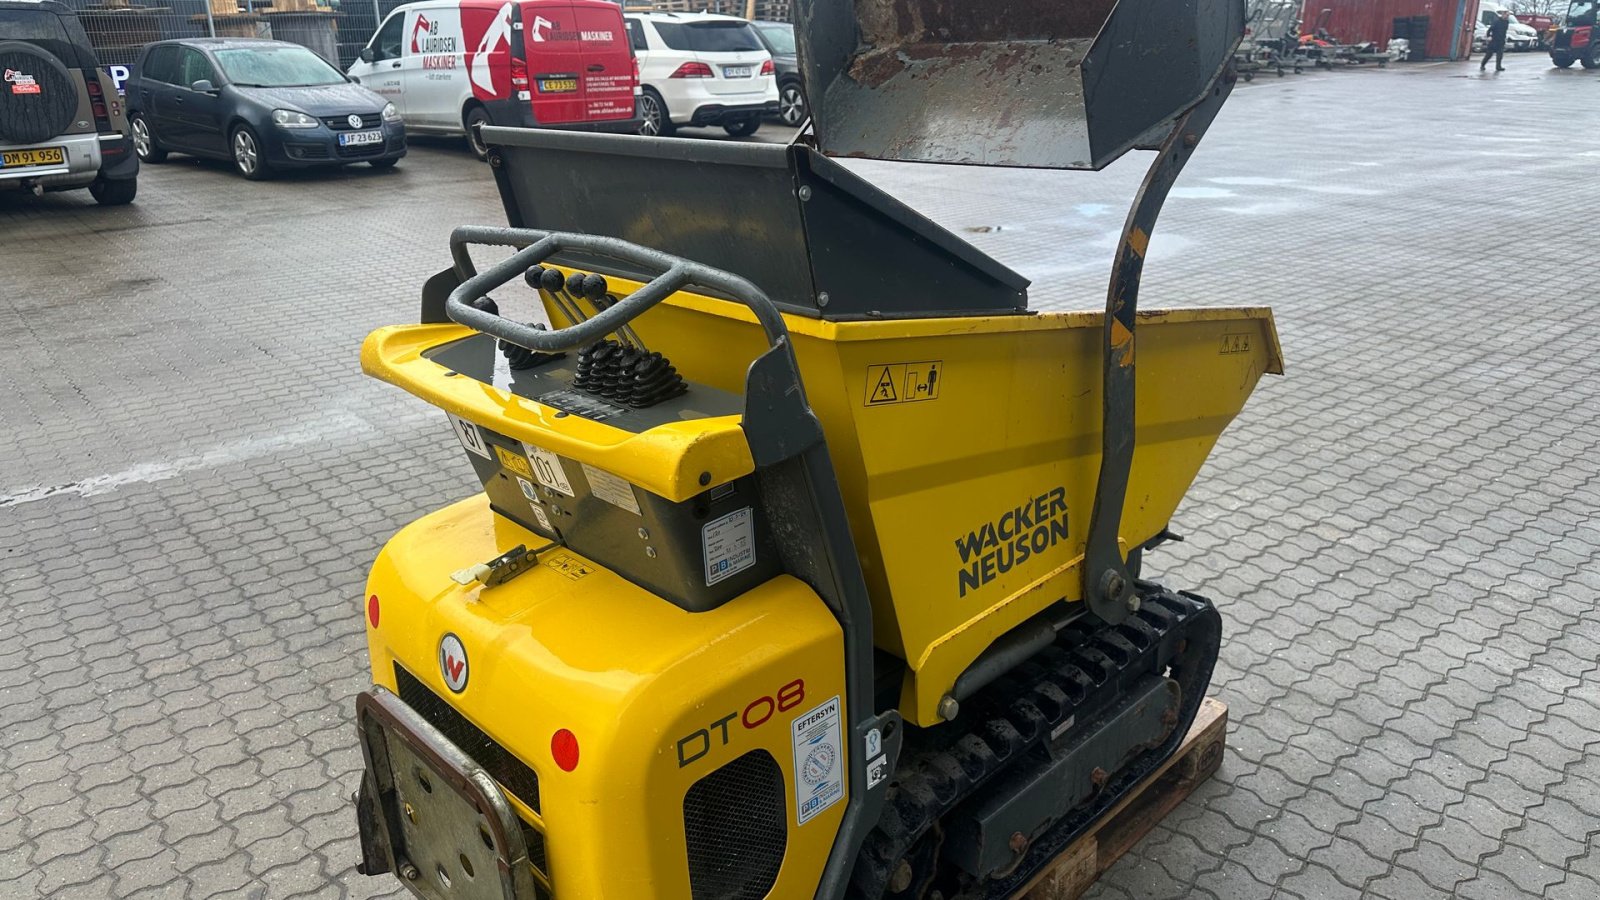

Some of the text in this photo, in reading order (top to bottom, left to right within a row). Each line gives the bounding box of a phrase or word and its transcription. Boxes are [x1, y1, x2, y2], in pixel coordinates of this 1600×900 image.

[429, 20, 438, 36] AB
[581, 31, 613, 41] MASKINER
[422, 37, 456, 53] LAURIDSEN
[423, 55, 456, 70] MASKINER
[110, 66, 129, 89] P
[346, 132, 381, 143] JF 23 623
[3, 149, 60, 164] DM 91 956
[459, 419, 482, 450] 87
[530, 454, 560, 488] 101
[955, 486, 1068, 564] WACKER
[959, 512, 1069, 598] NEUSON
[677, 678, 805, 769] DT08
[797, 703, 836, 731] EFTERSYN
